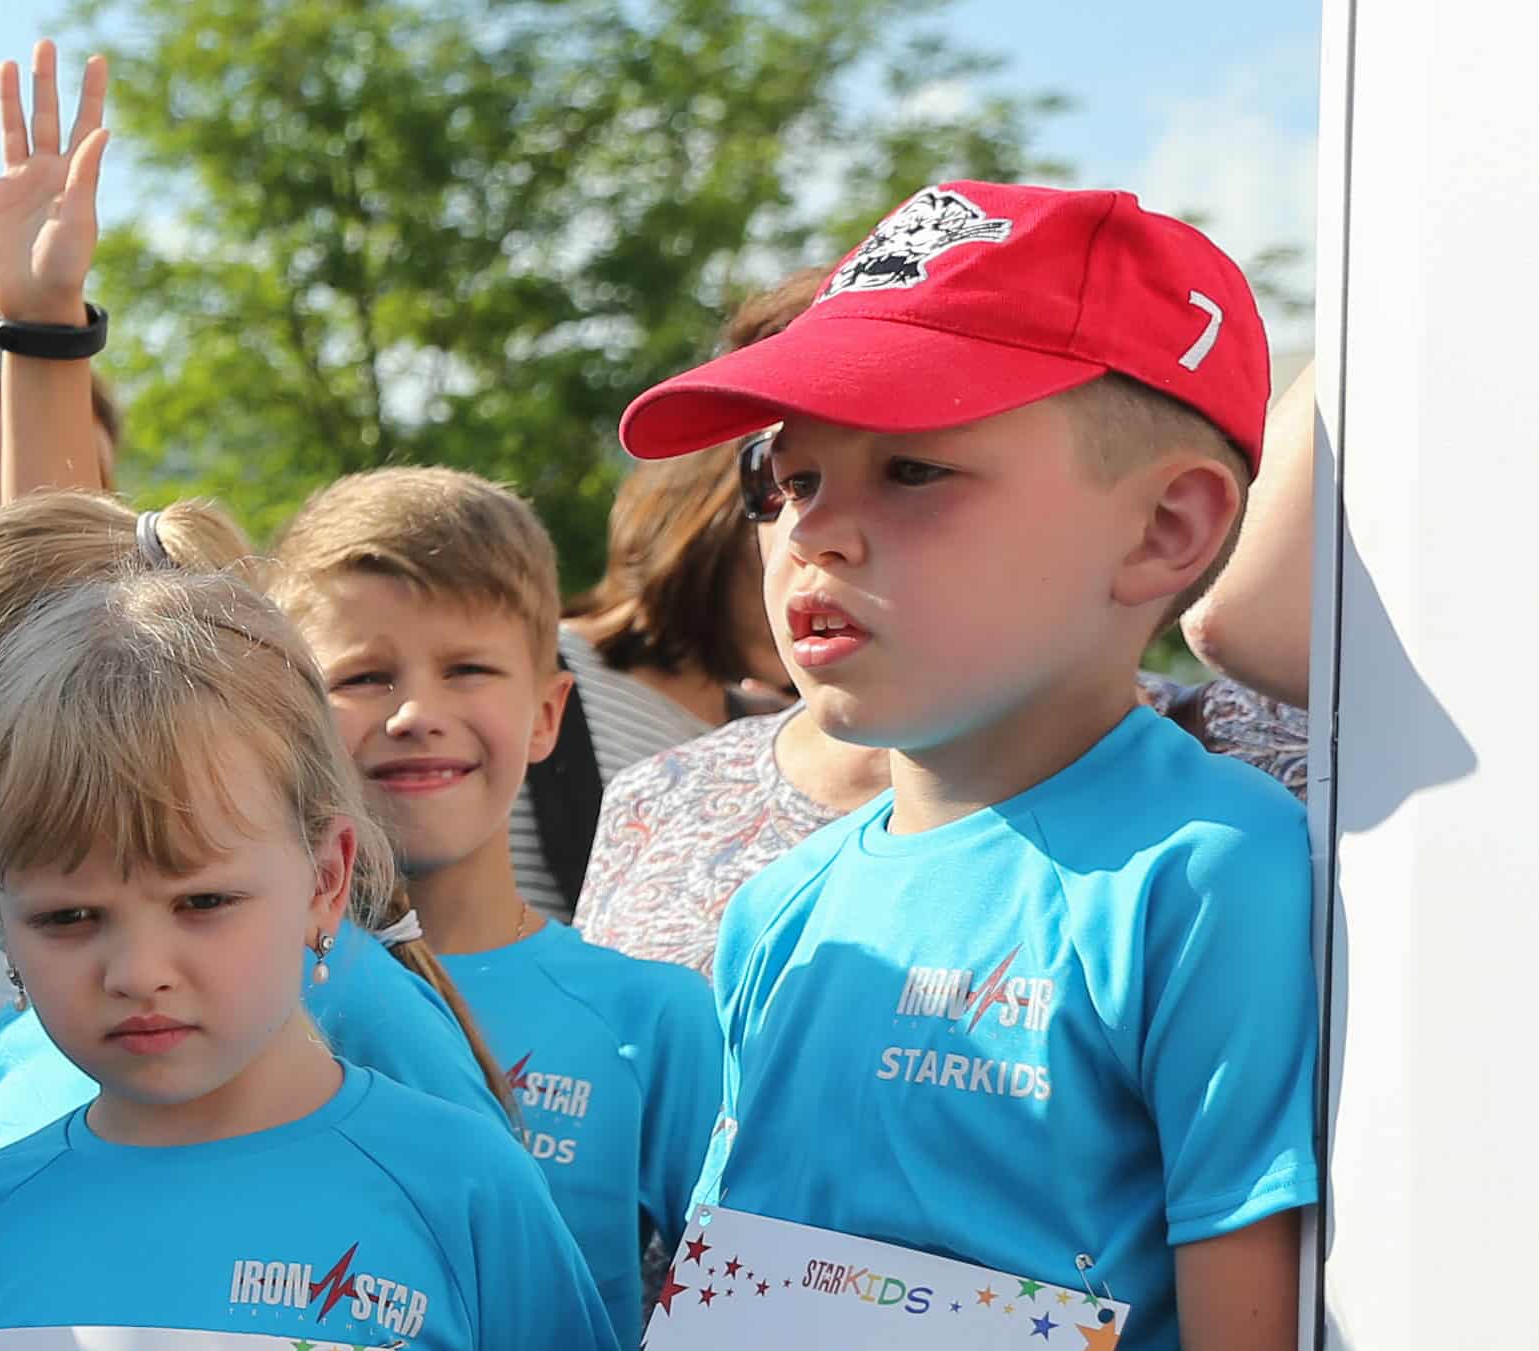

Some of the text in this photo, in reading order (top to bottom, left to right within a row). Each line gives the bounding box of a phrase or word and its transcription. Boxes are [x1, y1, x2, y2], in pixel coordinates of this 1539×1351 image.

[1178, 290, 1223, 371] 7
[876, 1047, 1051, 1100] STARKIDS
[802, 1259, 934, 1314] STARKIDS
